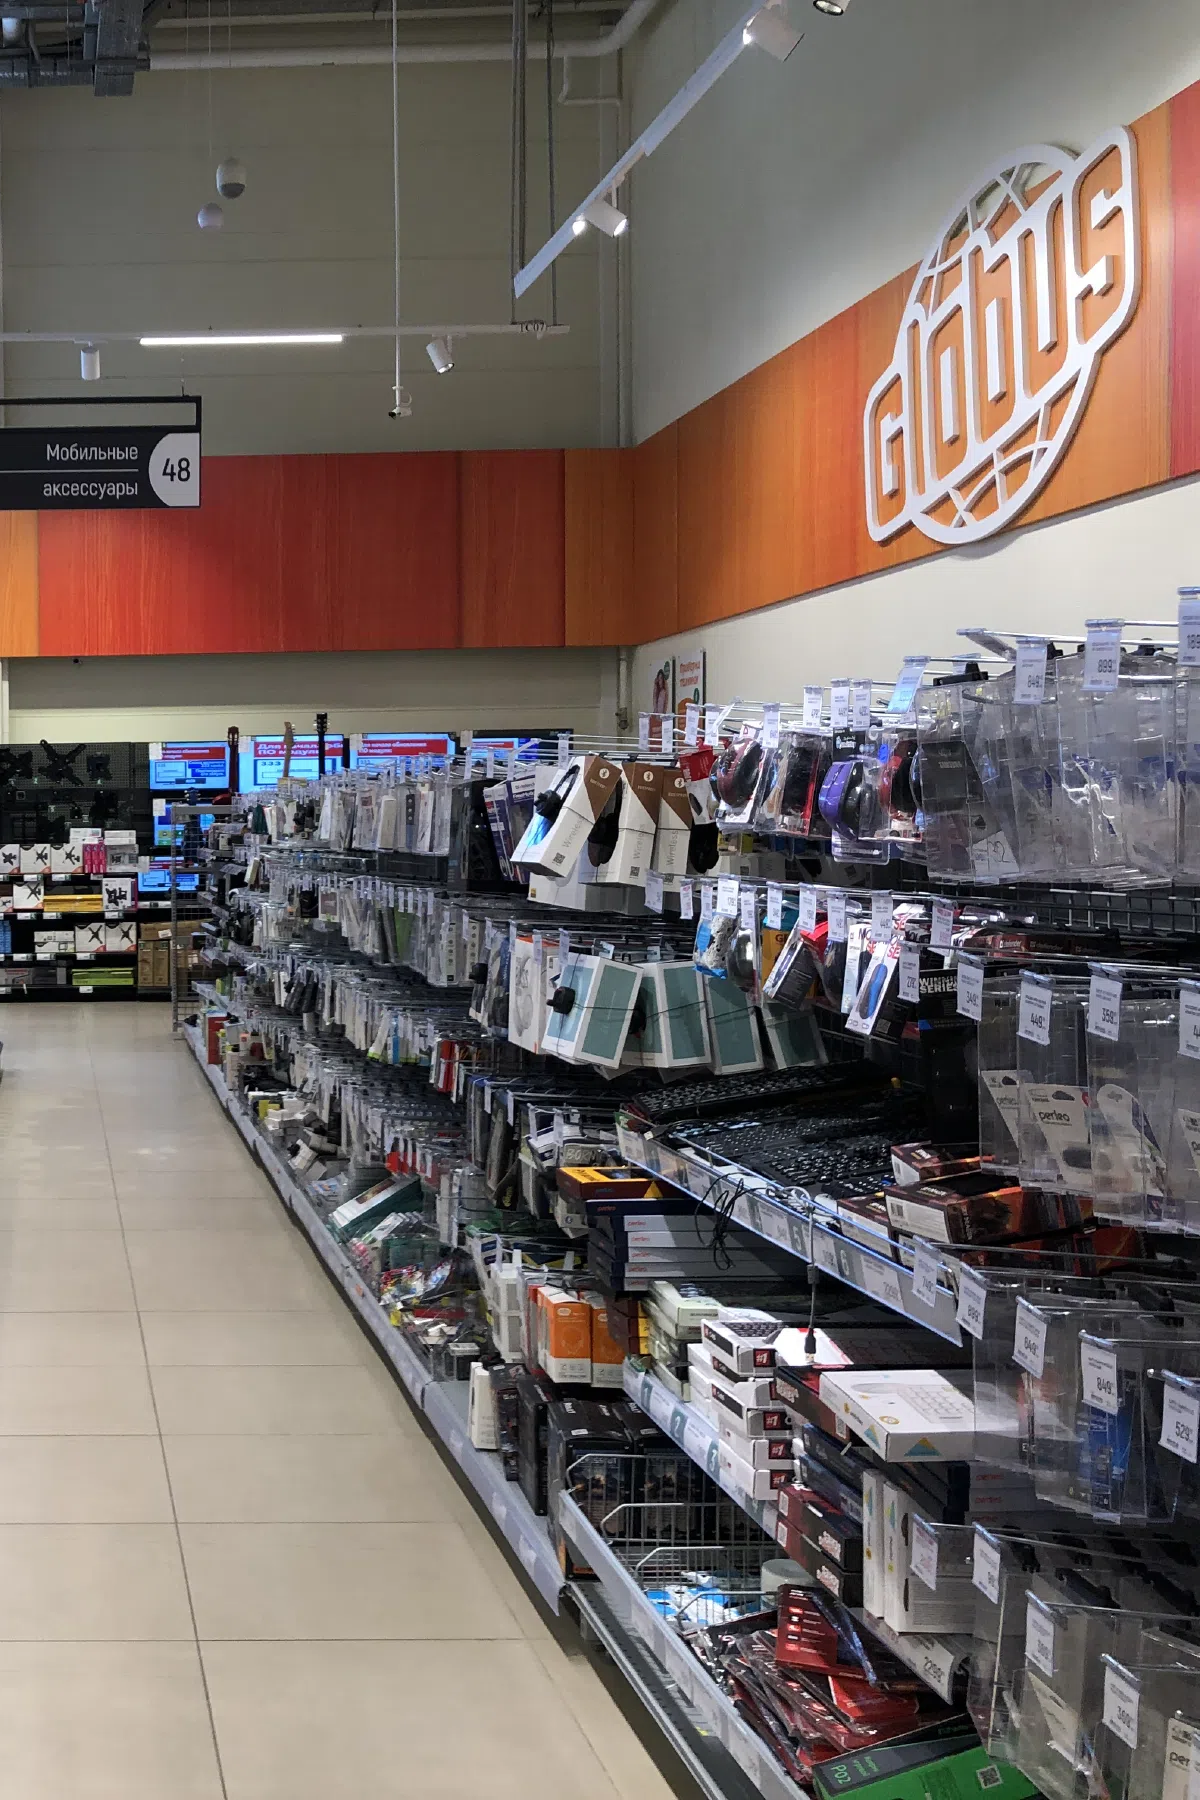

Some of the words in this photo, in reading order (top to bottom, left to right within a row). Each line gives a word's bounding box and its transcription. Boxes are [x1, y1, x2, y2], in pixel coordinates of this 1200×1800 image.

[46, 442, 139, 462] Мобильные
[162, 457, 191, 482] 48
[43, 481, 139, 500] аксессуары
[666, 830, 679, 866] Wireless
[1030, 1012, 1043, 1030] 449
[1174, 1421, 1191, 1443] 529
